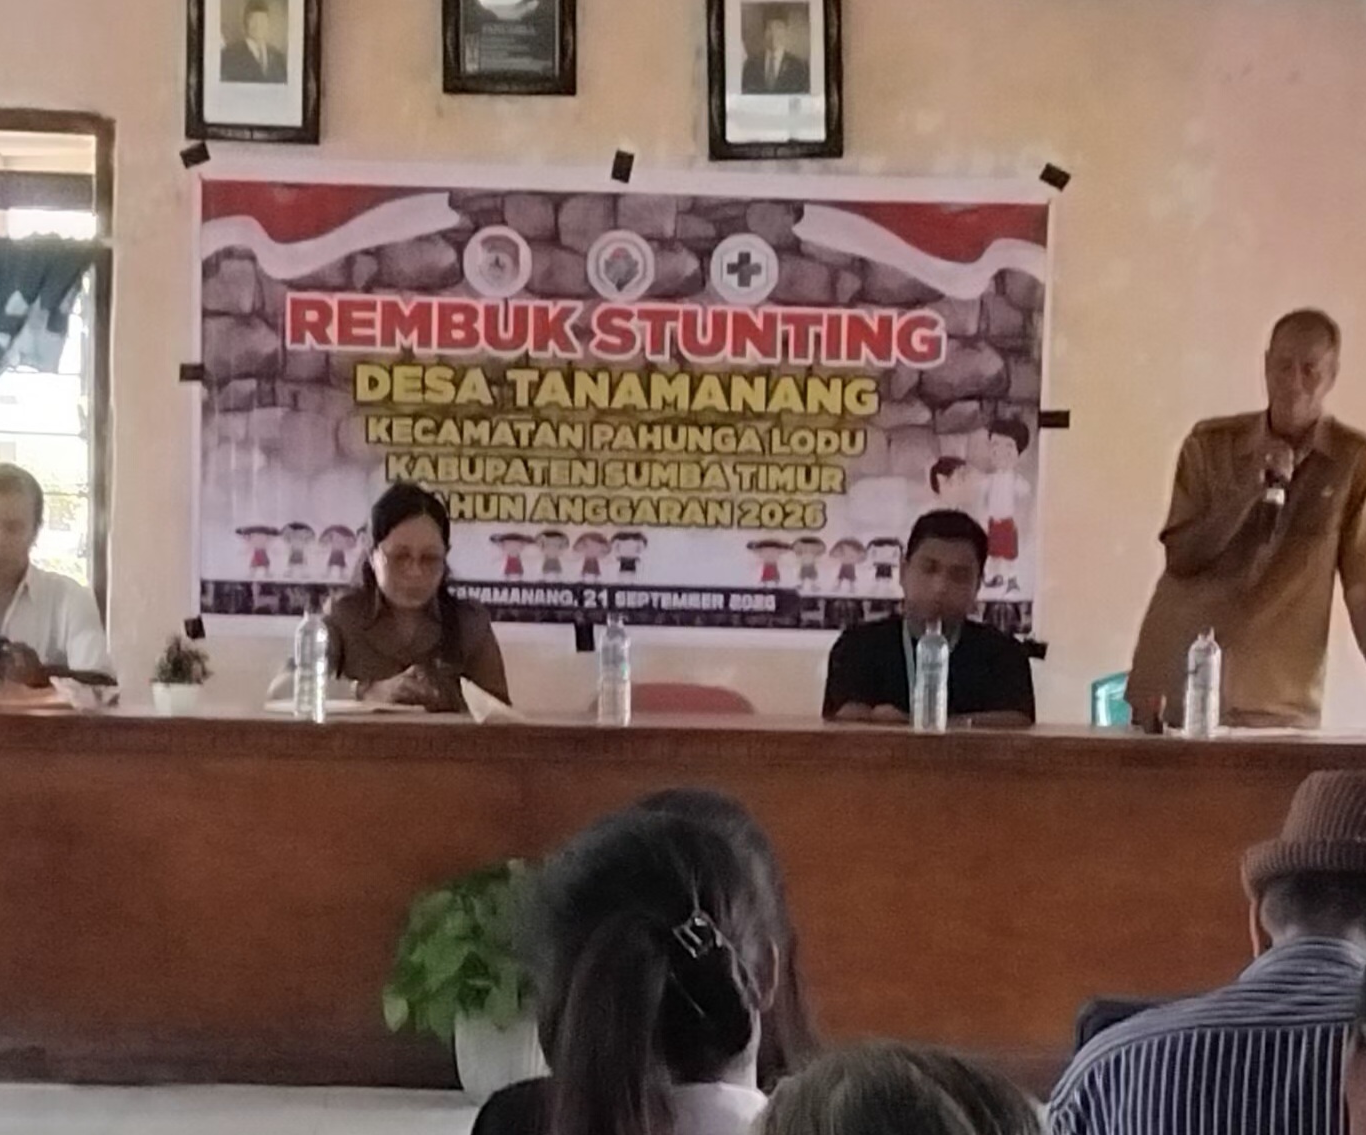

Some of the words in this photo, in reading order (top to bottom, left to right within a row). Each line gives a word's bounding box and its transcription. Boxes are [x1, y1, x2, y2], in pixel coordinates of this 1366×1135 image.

[287, 293, 583, 358] REMBUK
[590, 302, 946, 368] STUNTING
[354, 363, 494, 405] DESA
[506, 367, 879, 416] TANAMANANG
[367, 415, 584, 448] KECAMATAN
[591, 421, 764, 454] PAHUNGA
[769, 426, 867, 456] LODU
[386, 453, 597, 486] KABUPATEN
[603, 458, 729, 490] SUMBA
[735, 463, 846, 494] TIMUR
[434, 491, 525, 521] HUN
[529, 493, 733, 527] ANGGARAN
[737, 499, 827, 529] 2026
[583, 589, 609, 608] 21
[615, 590, 725, 611] SEPTEMBER
